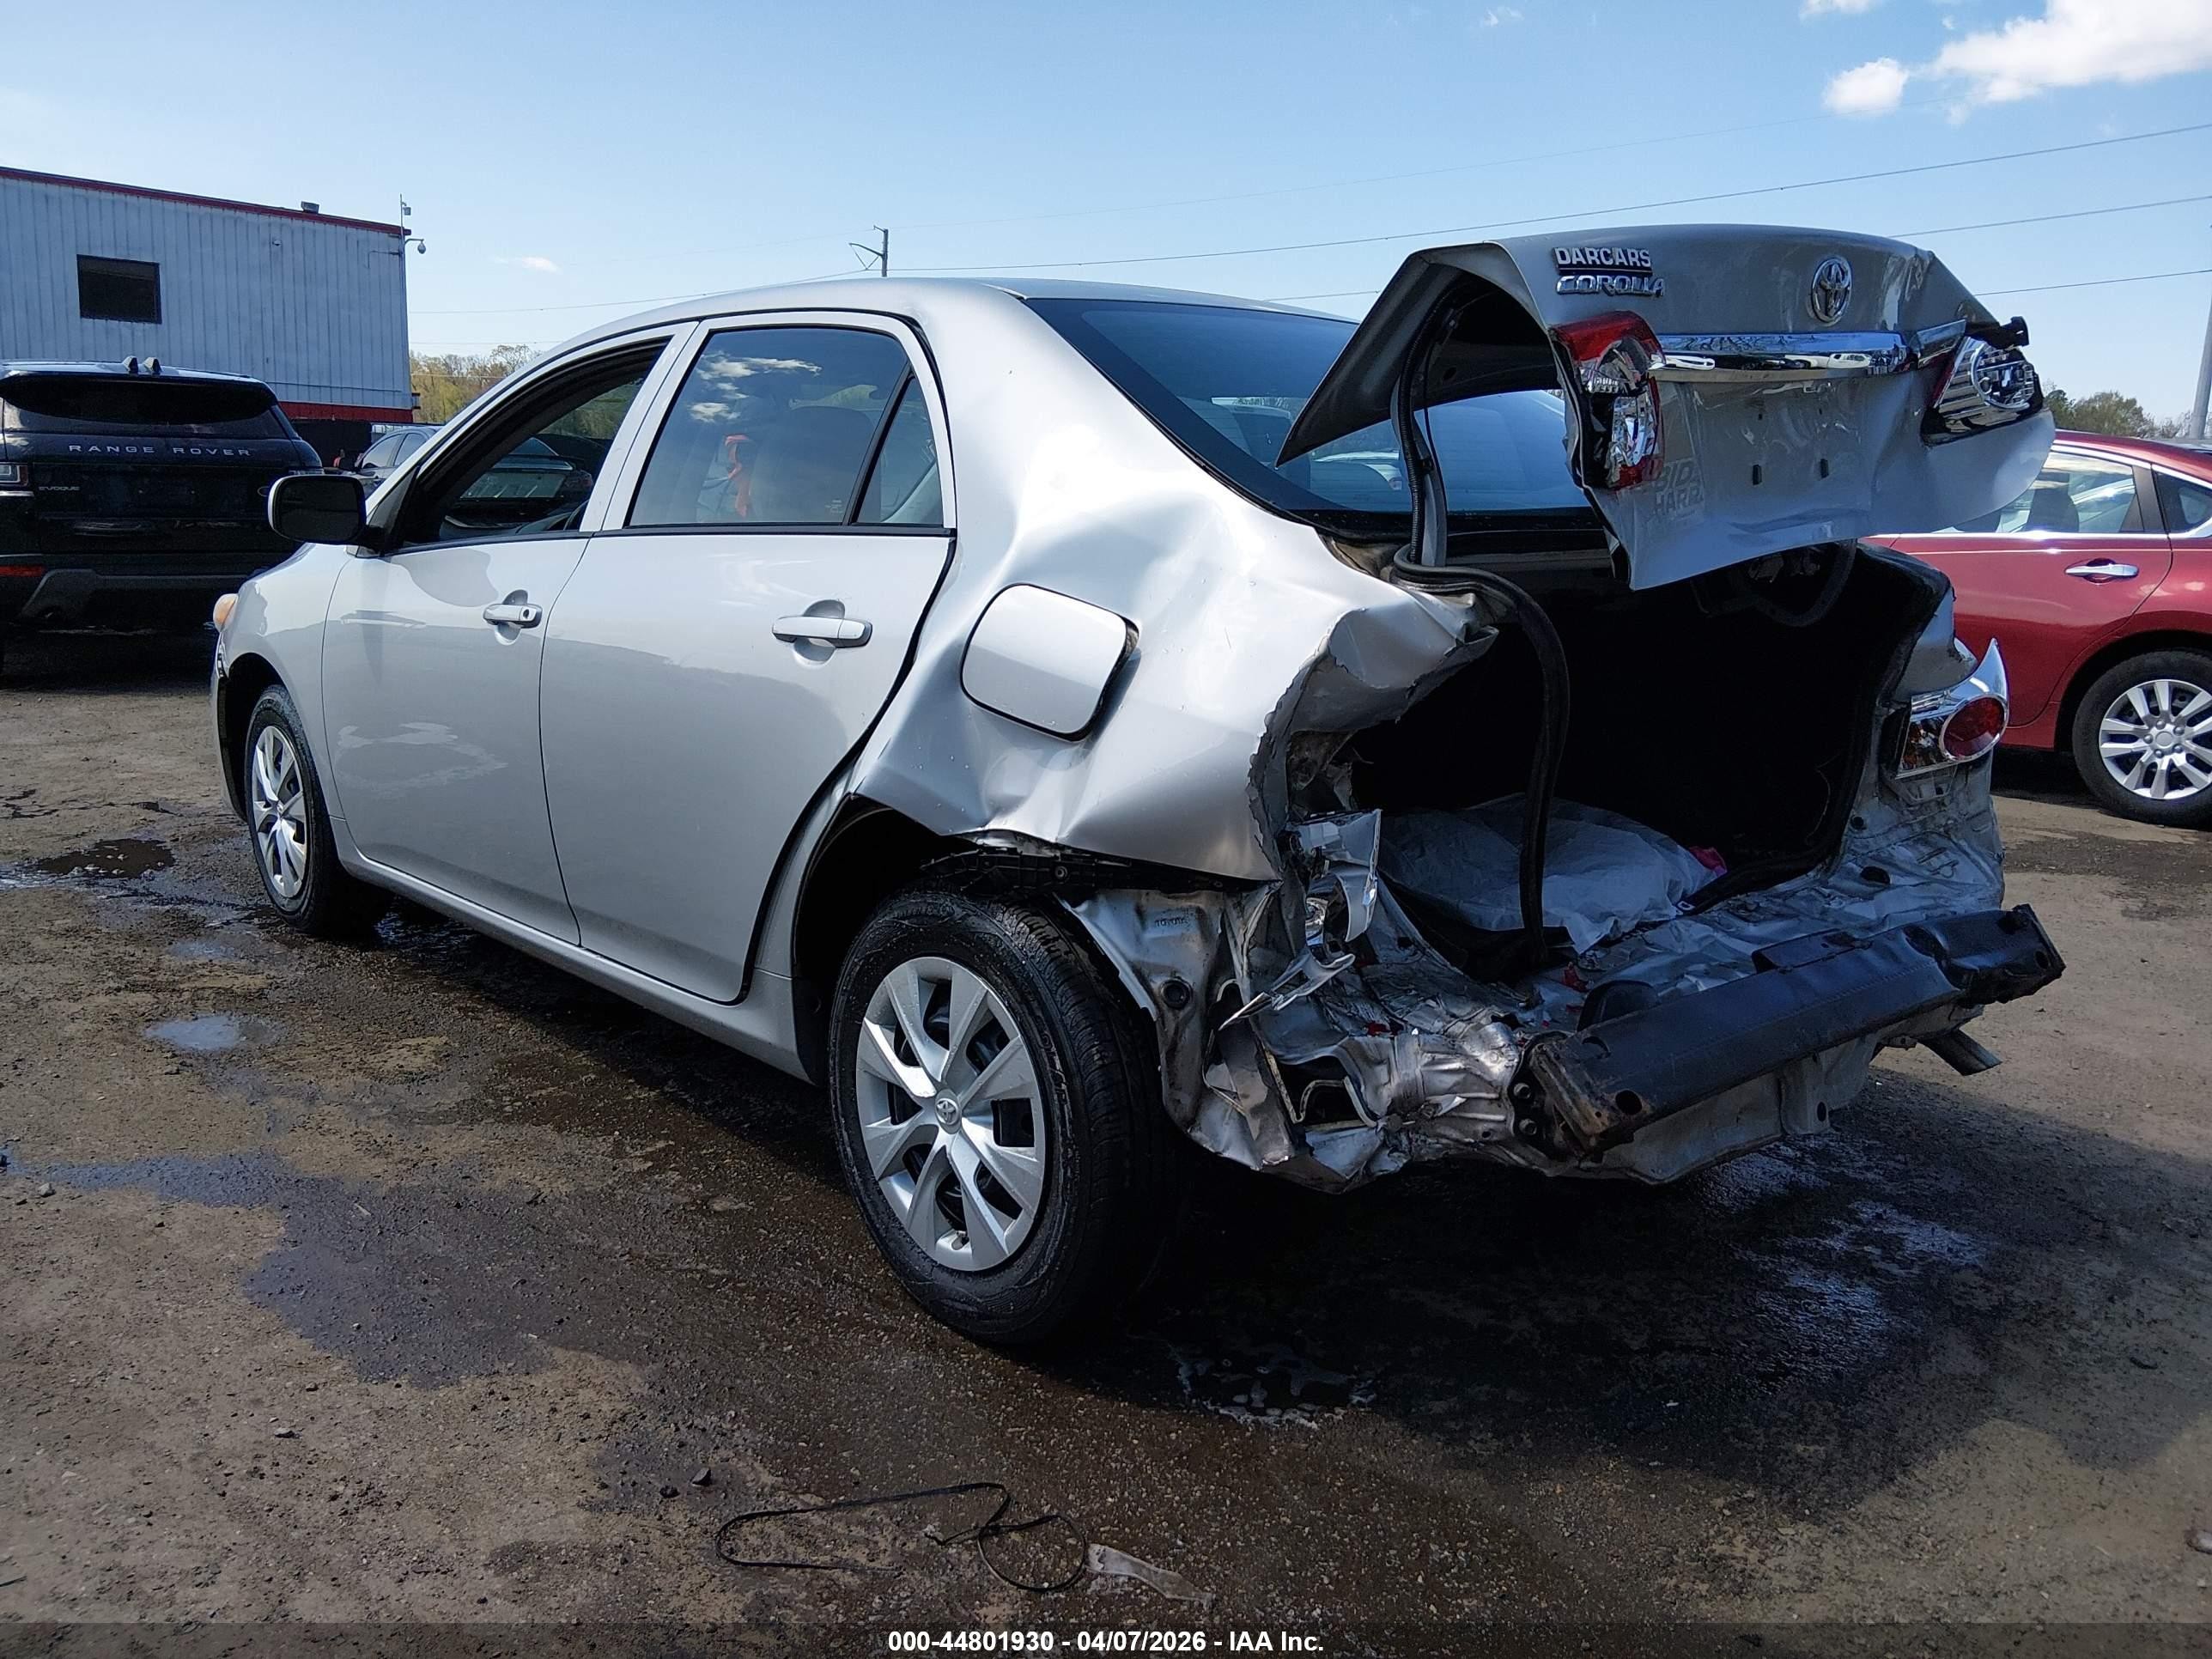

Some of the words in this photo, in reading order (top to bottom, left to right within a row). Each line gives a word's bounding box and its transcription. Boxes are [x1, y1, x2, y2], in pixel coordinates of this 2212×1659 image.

[1554, 246, 1652, 267] DARCARS
[1556, 275, 1665, 296] COROLLA
[69, 445, 155, 453] RANGE
[173, 447, 252, 456] ROVER
